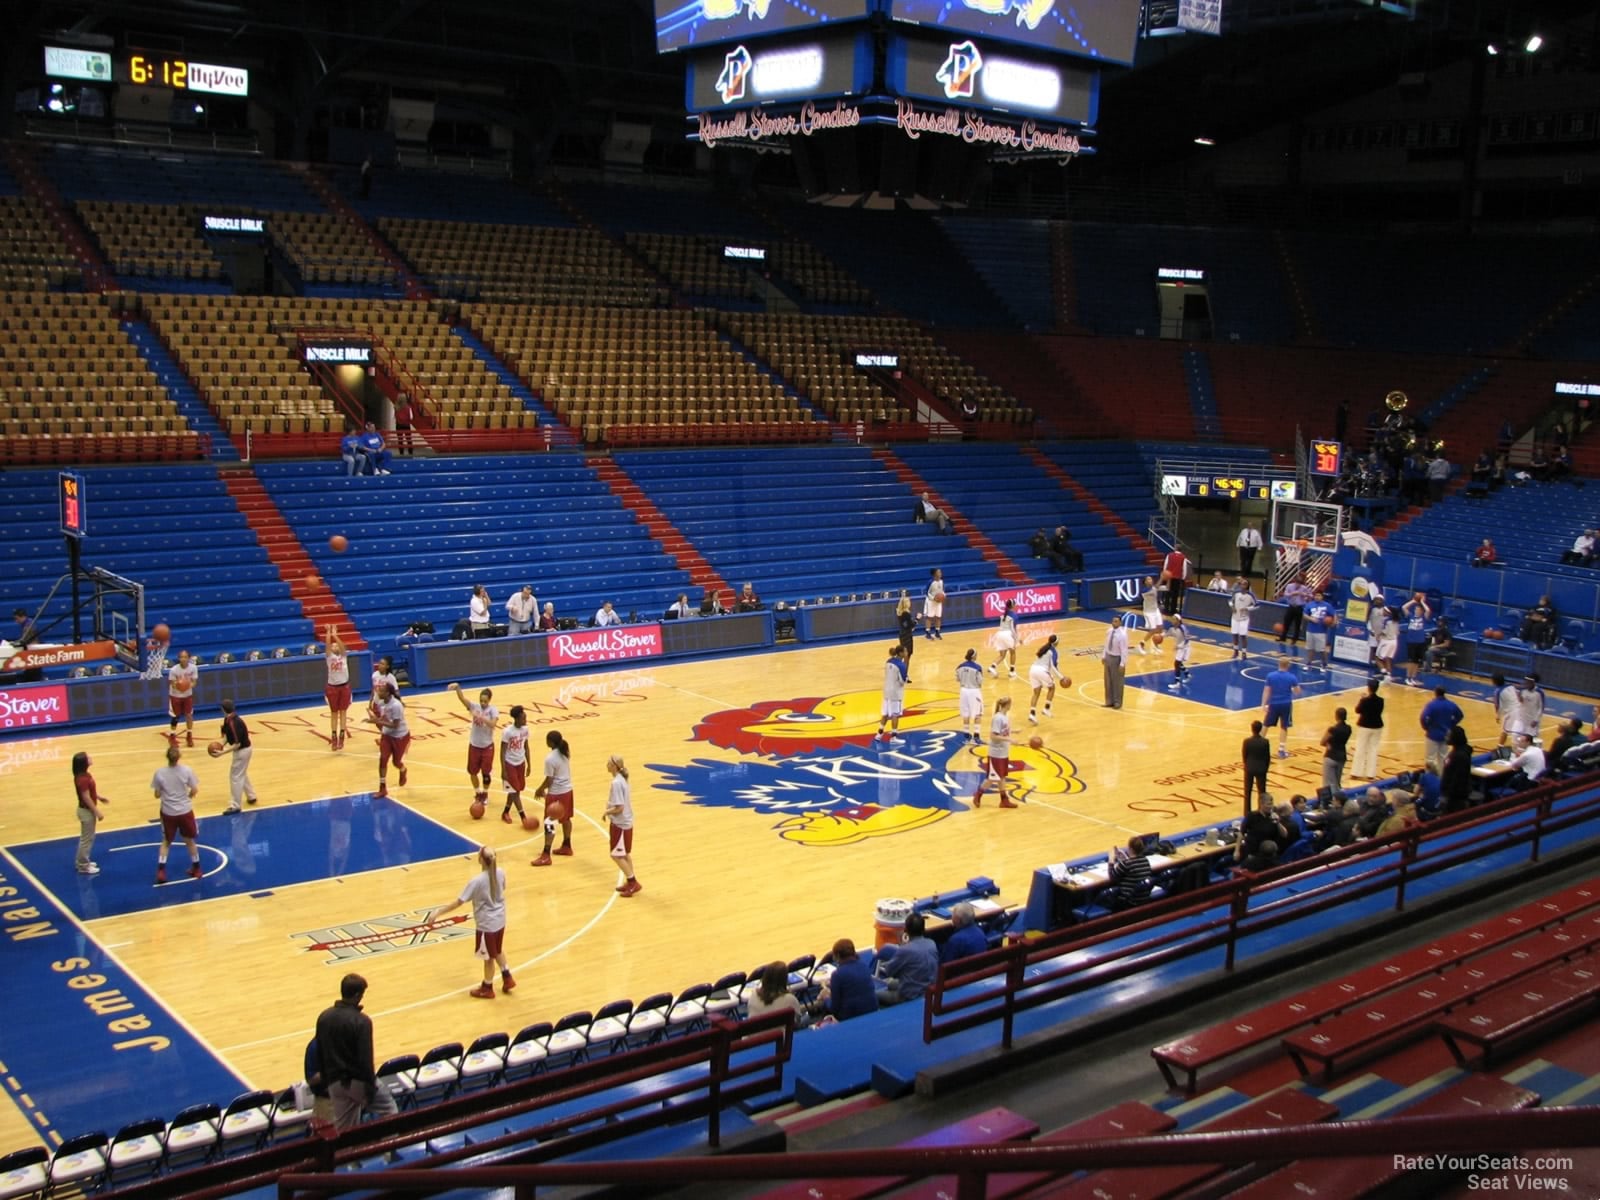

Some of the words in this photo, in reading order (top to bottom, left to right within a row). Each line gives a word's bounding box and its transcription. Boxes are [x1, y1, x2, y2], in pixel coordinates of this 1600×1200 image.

[130, 56, 187, 87] 6:12
[699, 110, 748, 148] Russell
[750, 105, 800, 141] Stover
[800, 101, 860, 135] Candies
[895, 97, 961, 139] Russell
[962, 111, 1019, 147] Stover
[1021, 119, 1080, 153] Candies
[205, 216, 240, 230] MUSCLE
[241, 217, 264, 232] MILK
[306, 347, 344, 361] MUSCLE
[345, 347, 369, 361] MILK
[1317, 454, 1336, 471] 30
[1199, 484, 1207, 496] 0
[1260, 487, 1269, 498] 0
[1024, 588, 1057, 607] Stover
[1115, 578, 1140, 602] KU
[1016, 604, 1054, 614] ANDIES
[552, 633, 611, 659] Russell
[610, 629, 657, 651] Stover
[588, 648, 652, 662] CANDIES
[794, 750, 931, 787] KU
[0, 873, 60, 941] Nais
[51, 956, 171, 1053] James
